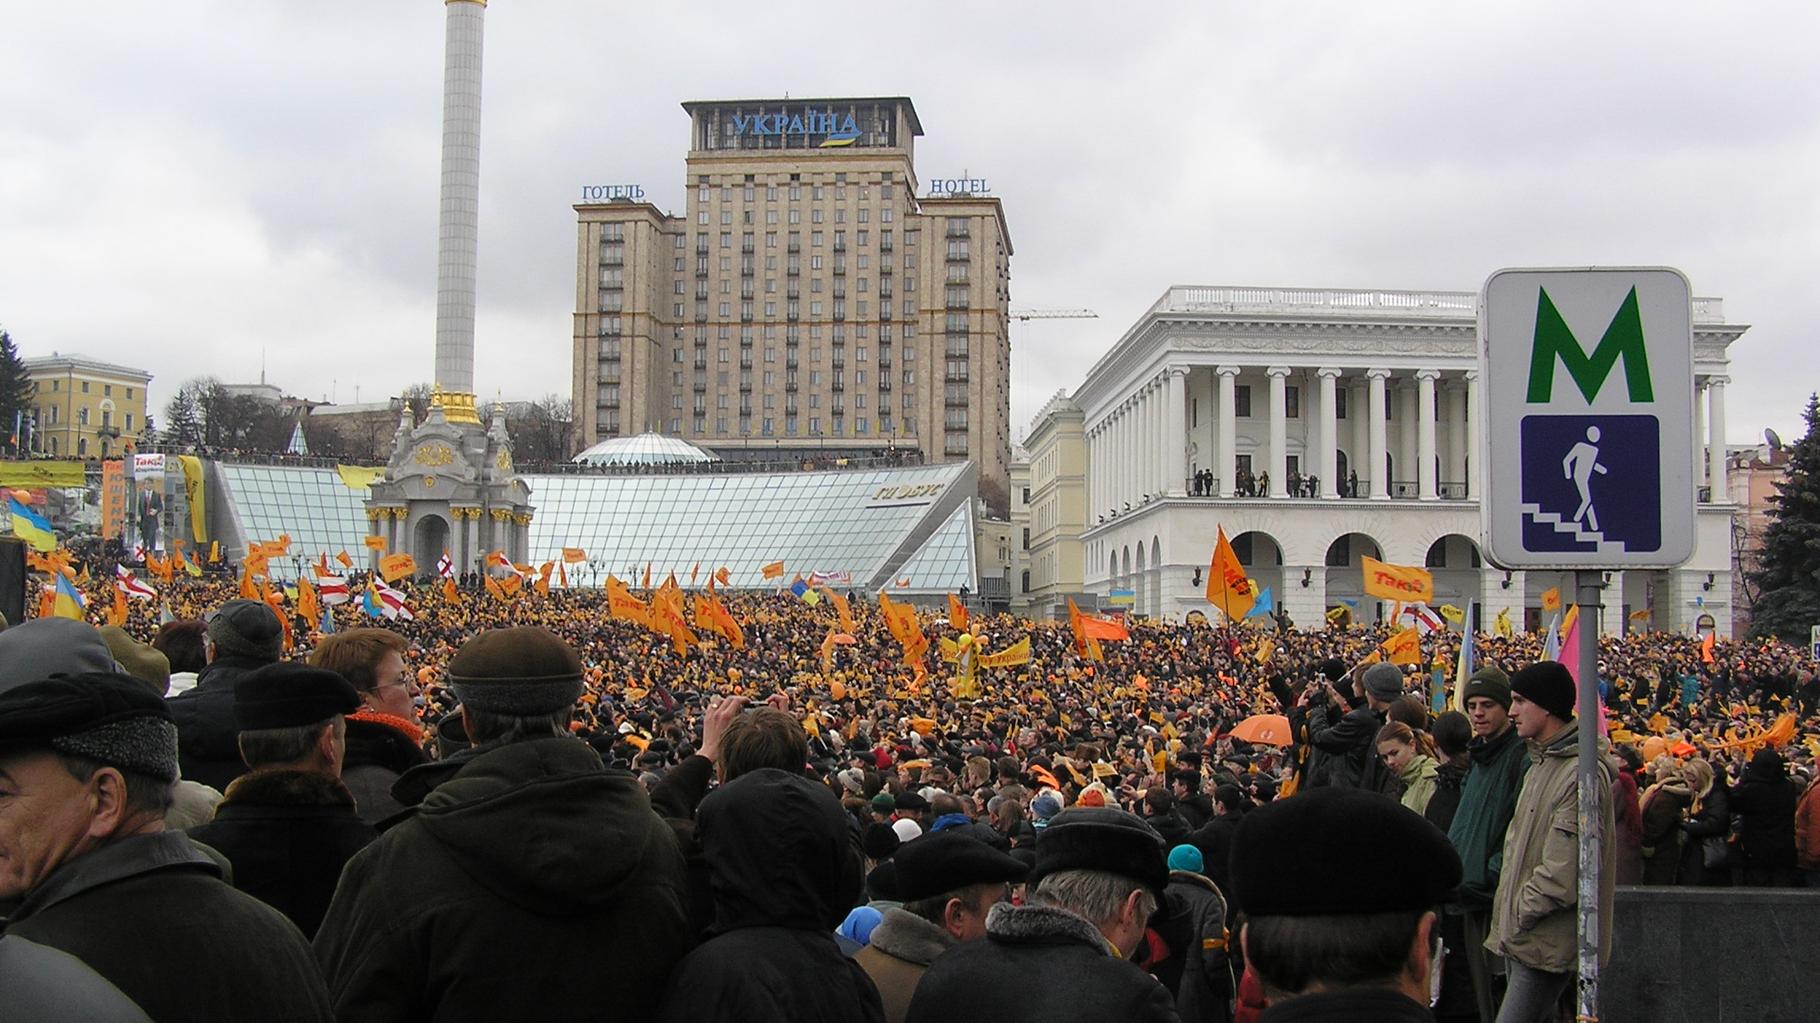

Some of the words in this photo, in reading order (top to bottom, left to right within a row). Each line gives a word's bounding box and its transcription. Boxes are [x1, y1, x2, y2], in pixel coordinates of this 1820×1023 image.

[732, 110, 860, 135] УКРАЇНА
[582, 185, 645, 199] ГОТЕЛЬ
[930, 179, 991, 193] HOTEL
